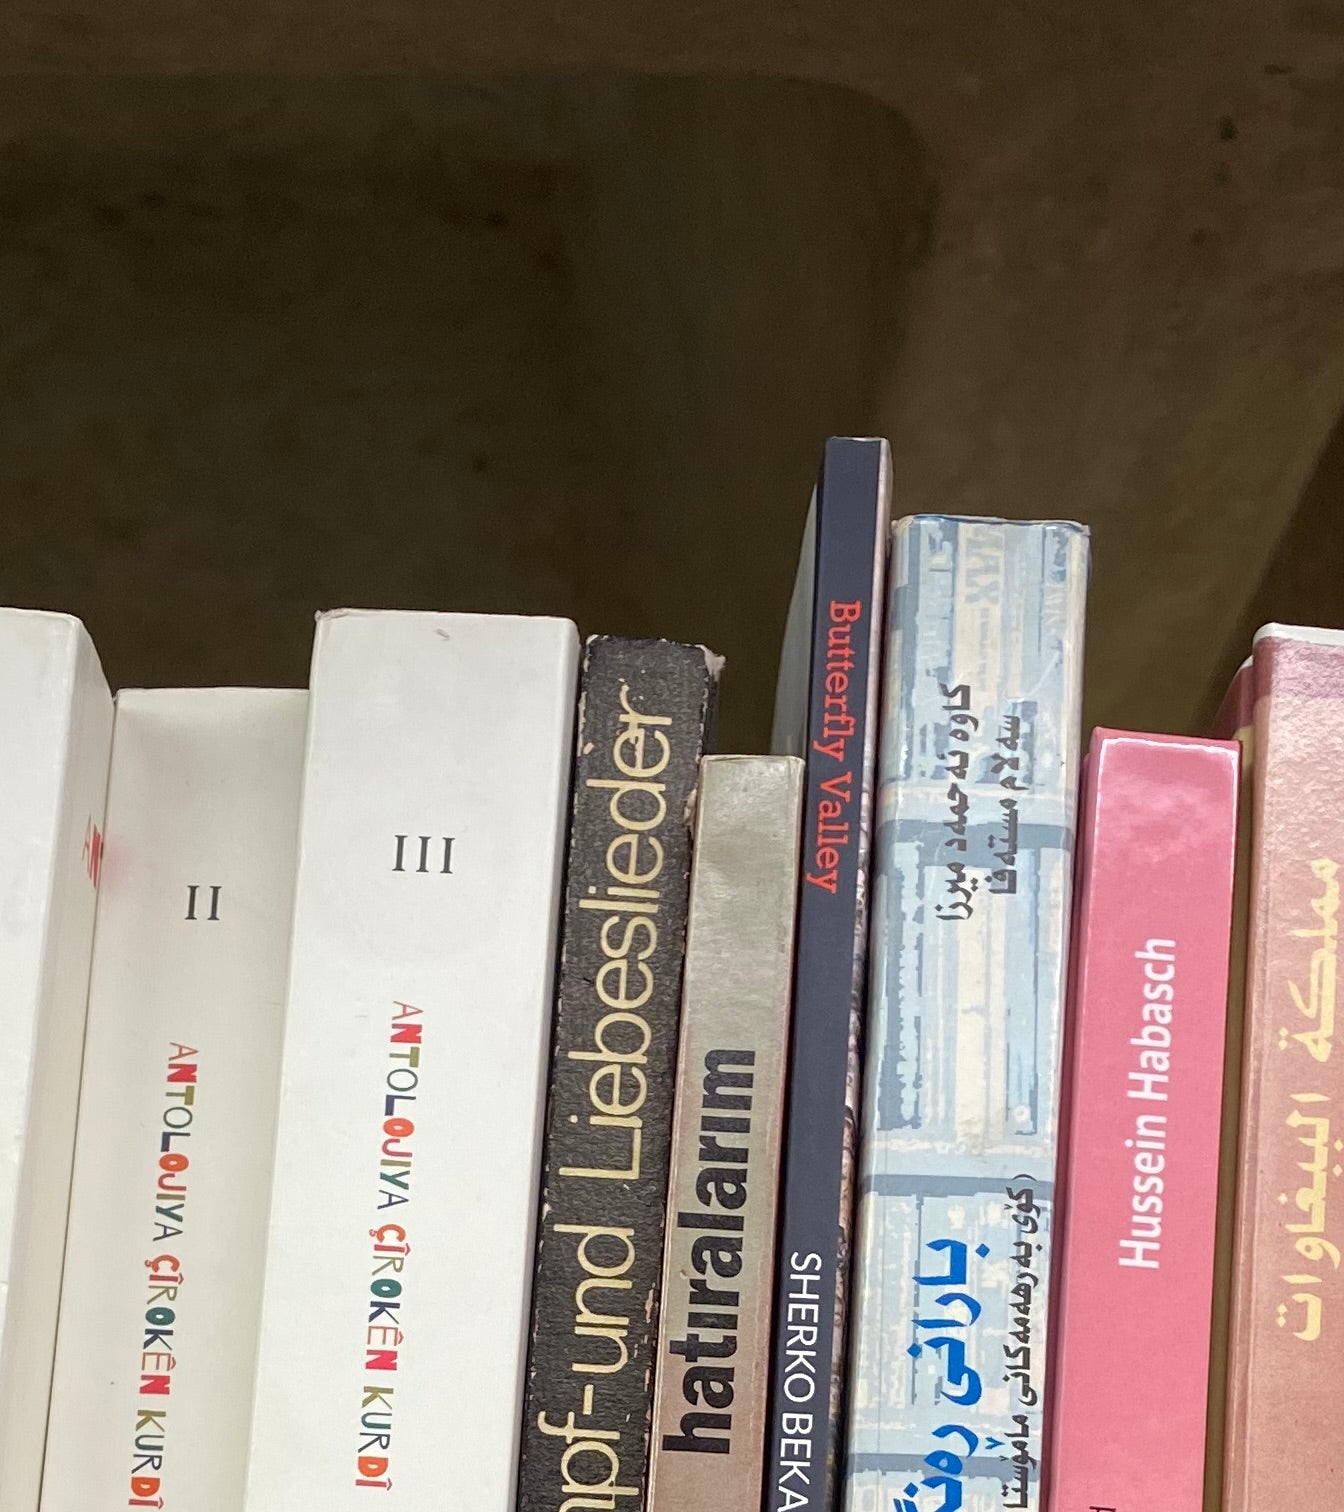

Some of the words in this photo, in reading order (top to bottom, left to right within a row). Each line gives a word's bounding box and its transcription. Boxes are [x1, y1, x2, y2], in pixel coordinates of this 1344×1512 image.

[813, 600, 861, 763] Butterfly
[184, 885, 223, 921] II
[392, 835, 456, 874] III
[806, 772, 850, 894] Valley
[559, 681, 672, 1180] Liebeslieder
[1127, 937, 1177, 1100] Habasch
[153, 1041, 199, 1241] ANTOLOJIYA
[377, 1001, 423, 1210] ANTOLOJIYA
[662, 1048, 755, 1454] hatıralarım
[1119, 1113, 1167, 1269] Hussein
[138, 1255, 184, 1396] ÇÎROKÊN
[365, 1224, 411, 1371] ÇÎROKÊN
[785, 1252, 822, 1404] SHERKO
[128, 1409, 167, 1509] KURDÎ
[355, 1386, 393, 1490] KURDÎ
